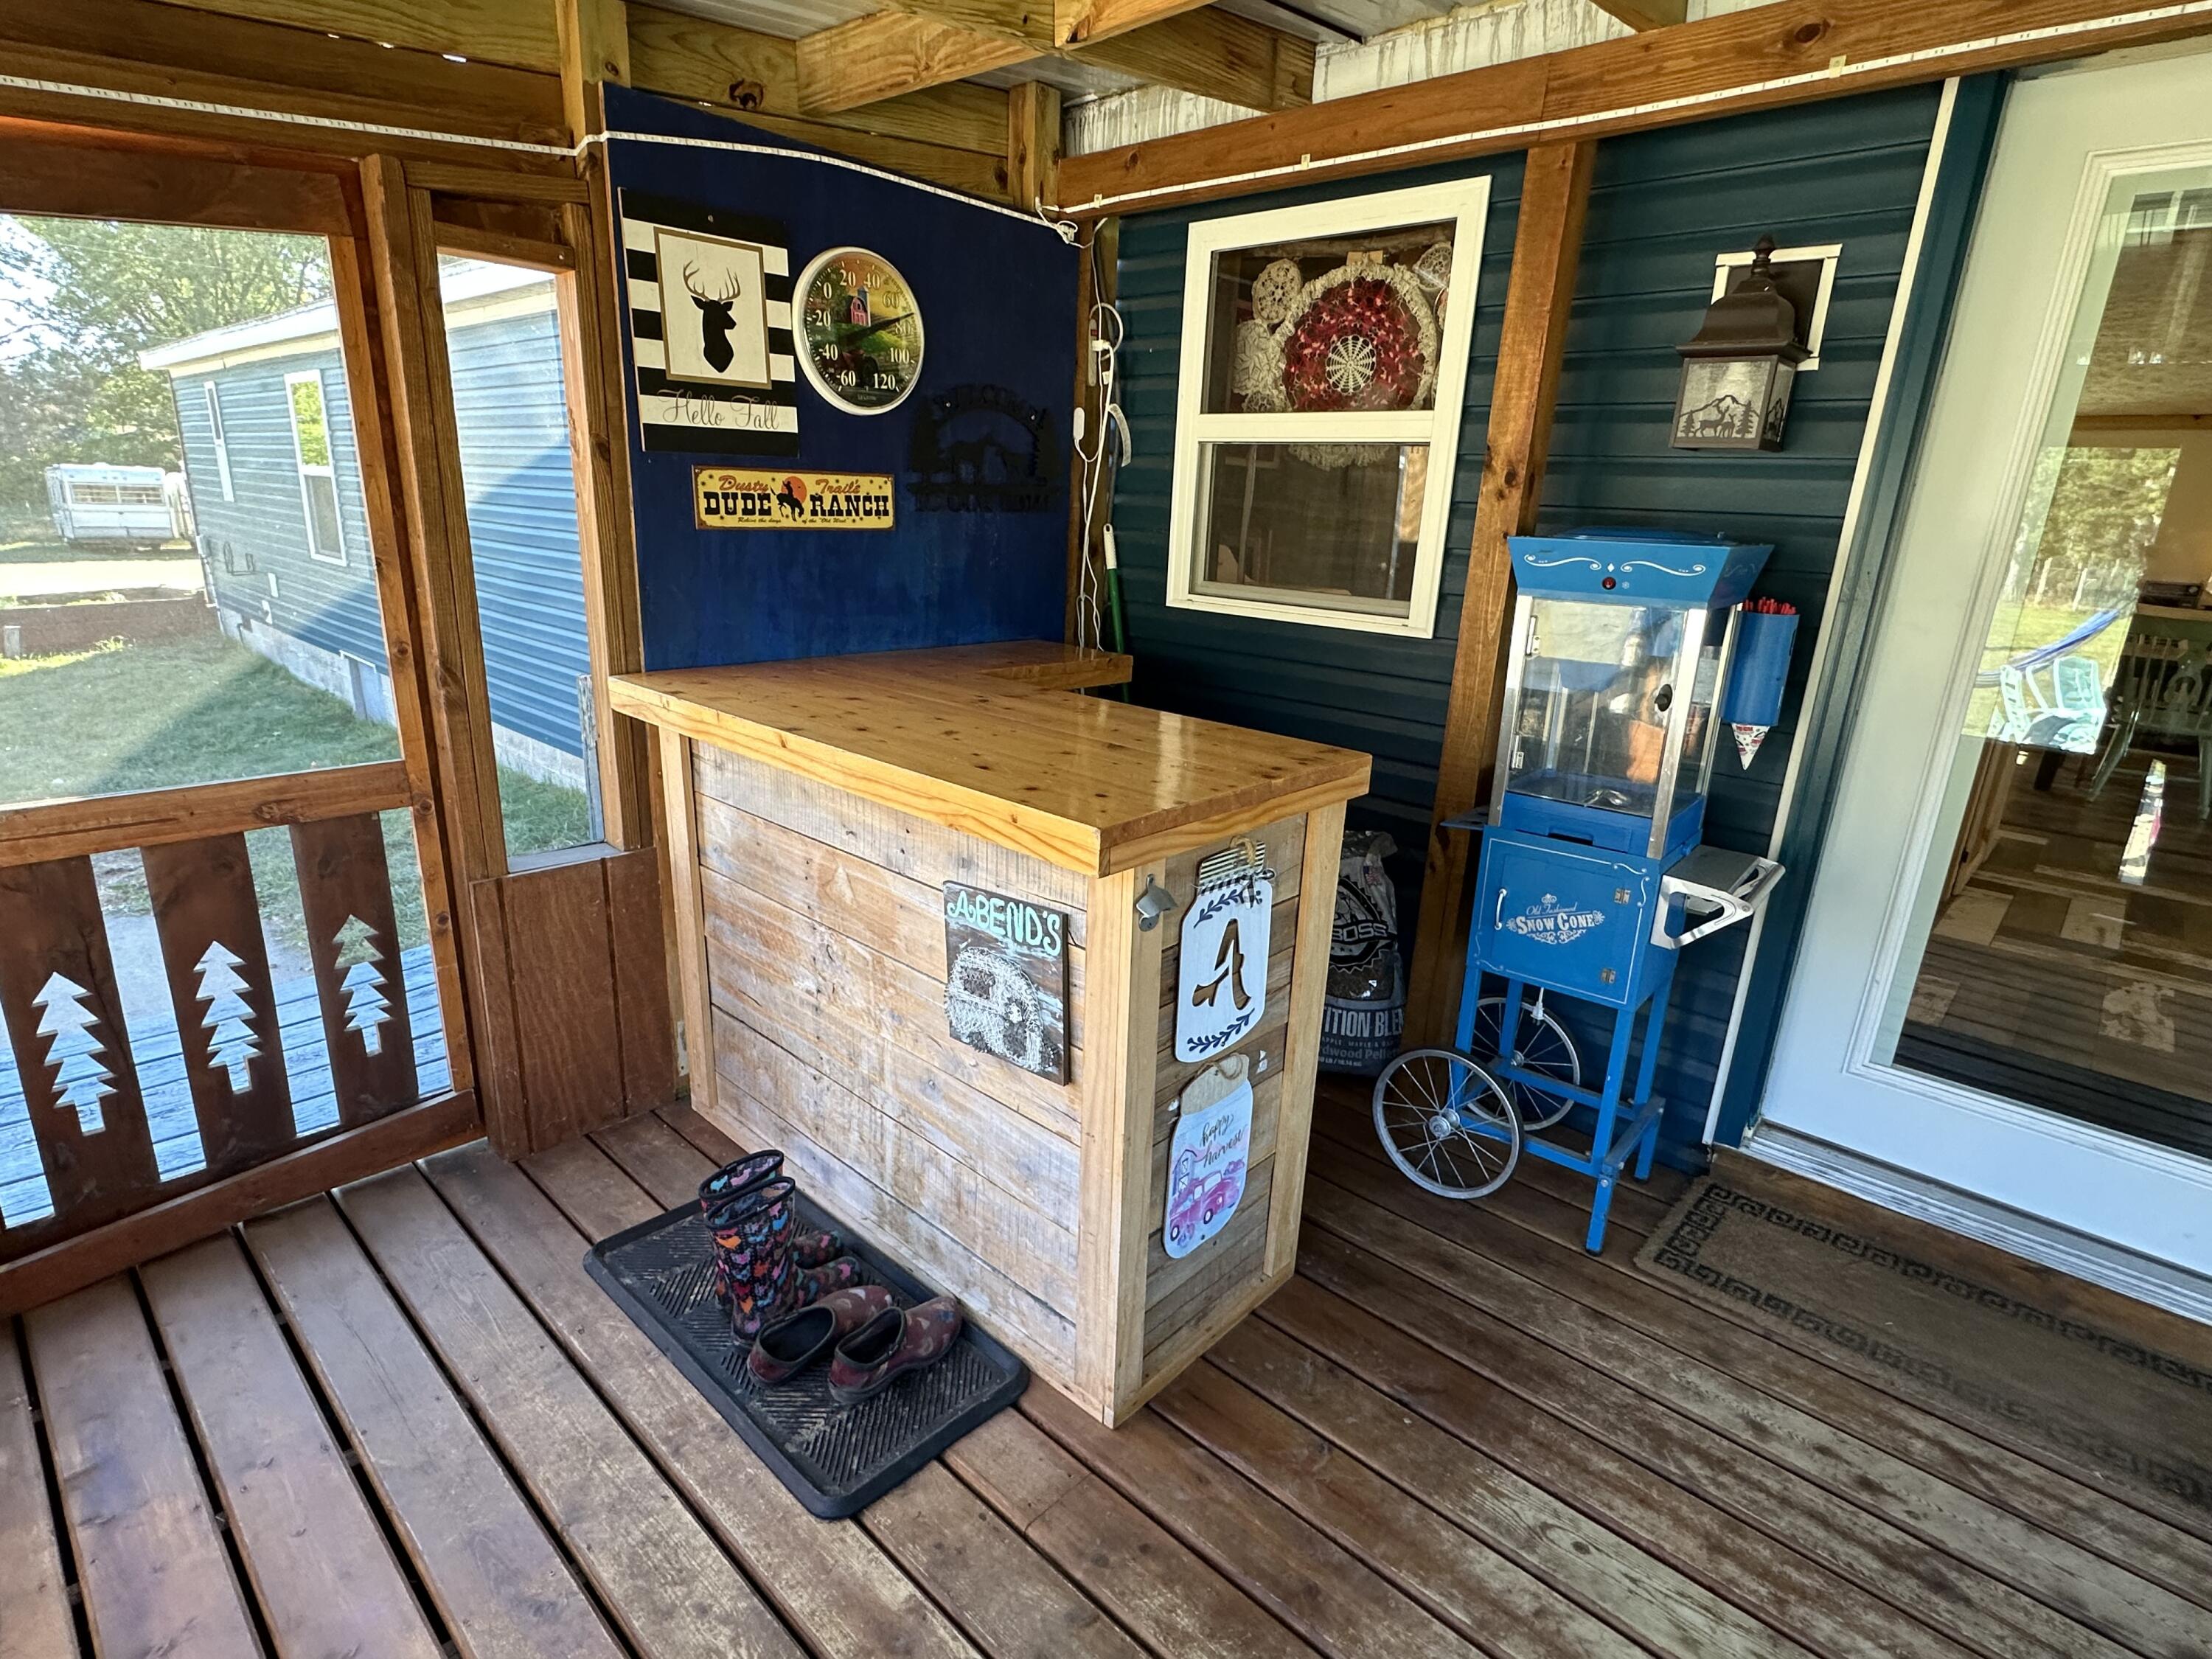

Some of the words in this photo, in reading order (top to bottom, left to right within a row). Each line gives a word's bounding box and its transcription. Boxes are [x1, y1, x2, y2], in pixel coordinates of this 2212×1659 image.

[839, 270, 856, 287] 20
[863, 273, 880, 289] 40
[823, 282, 832, 299] 0
[882, 290, 900, 309] 60
[895, 320, 911, 337] 80
[818, 344, 838, 361] -40
[889, 347, 910, 364] 100
[836, 369, 856, 386] -60
[873, 372, 896, 390] 120
[656, 389, 726, 426] Hello
[730, 394, 779, 430] Fall
[718, 474, 770, 493] Dusty
[703, 491, 772, 516] DUDE
[810, 495, 889, 517] RANCH
[1526, 905, 1542, 915] Old
[947, 890, 1062, 956] ABEND'S
[1516, 916, 1554, 935] SNOW
[1557, 913, 1595, 931] CONE
[1192, 918, 1252, 1011] A
[1324, 1006, 1371, 1037] ITION
[1322, 1044, 1363, 1060] dwood
[1200, 1114, 1234, 1147] happy
[1204, 1124, 1248, 1168] harvest
